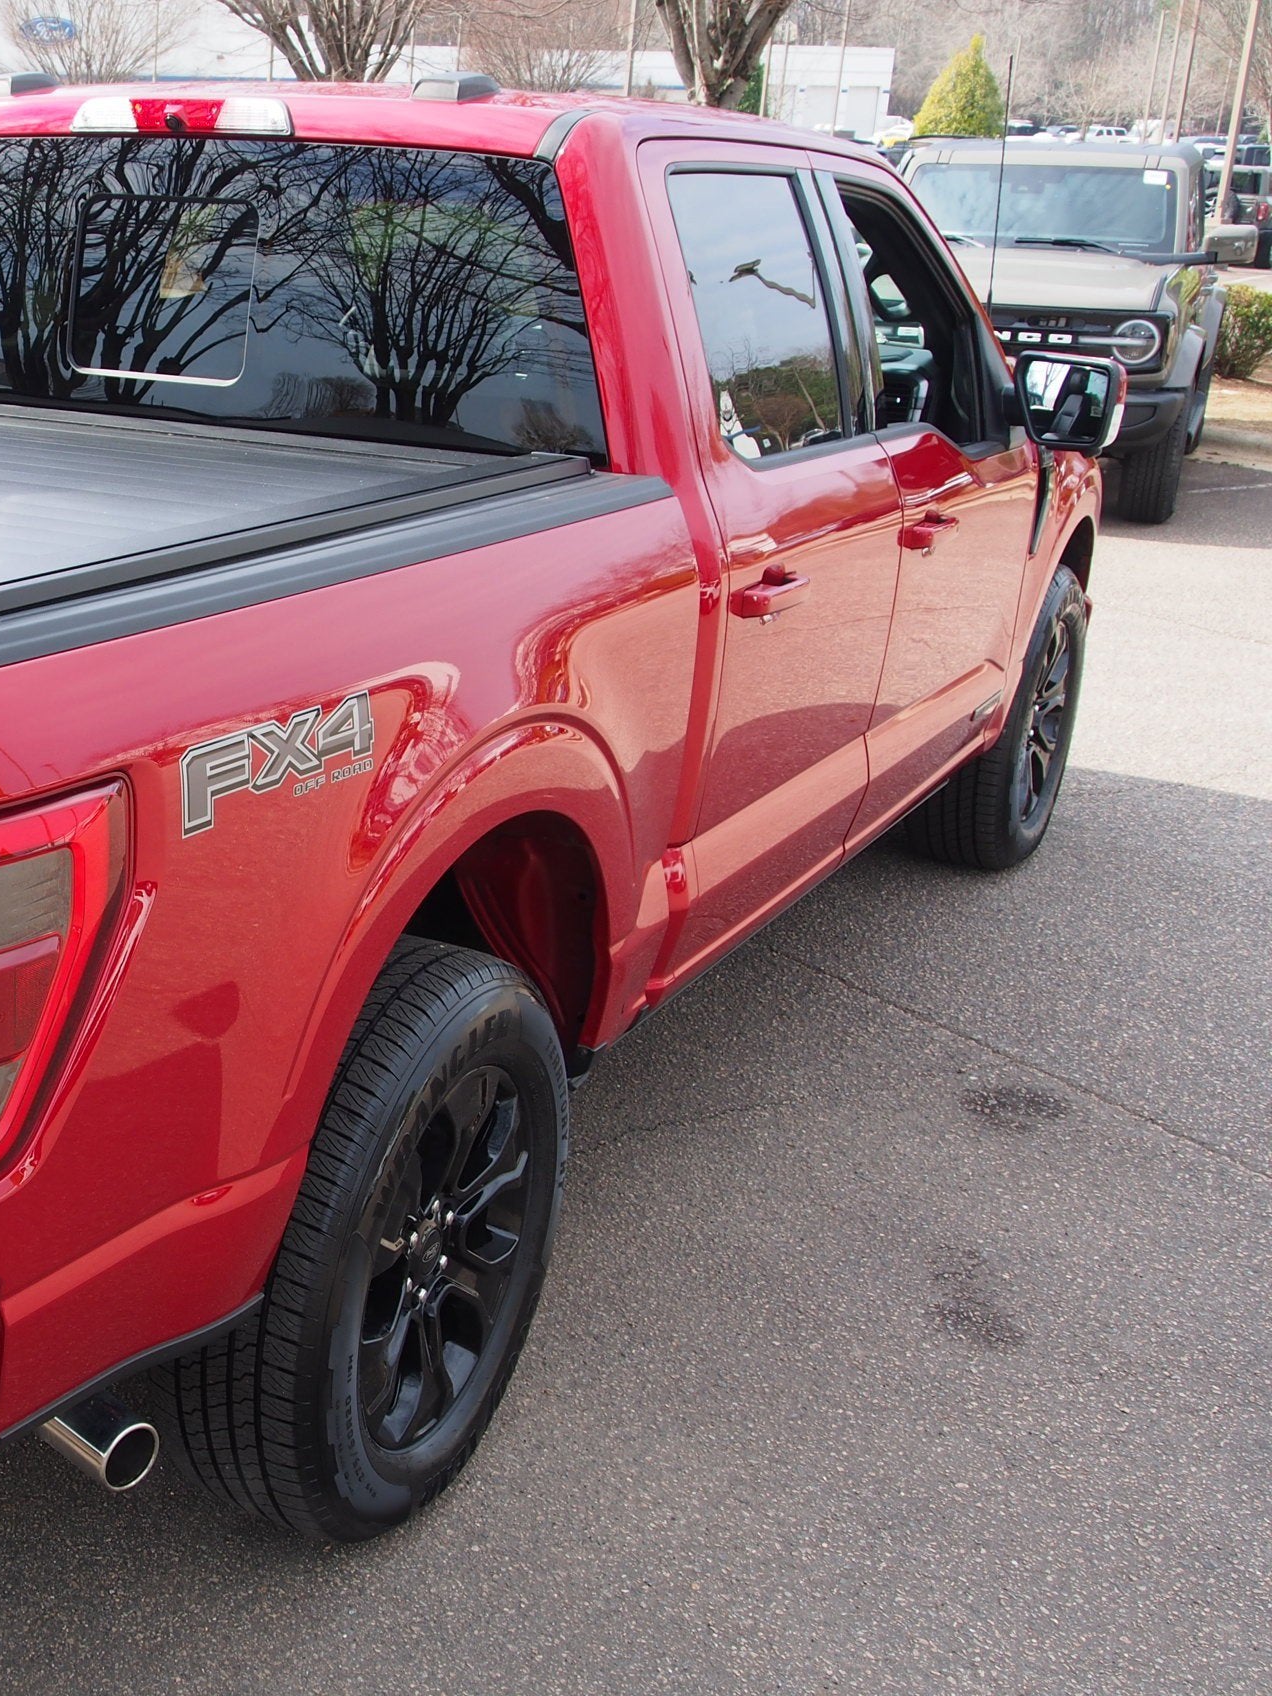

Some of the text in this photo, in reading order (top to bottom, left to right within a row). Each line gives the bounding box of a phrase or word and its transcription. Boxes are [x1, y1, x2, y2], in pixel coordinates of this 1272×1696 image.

[993, 331, 1073, 344] NCO
[179, 690, 374, 839] FX4
[293, 758, 373, 797] OFF ROAD
